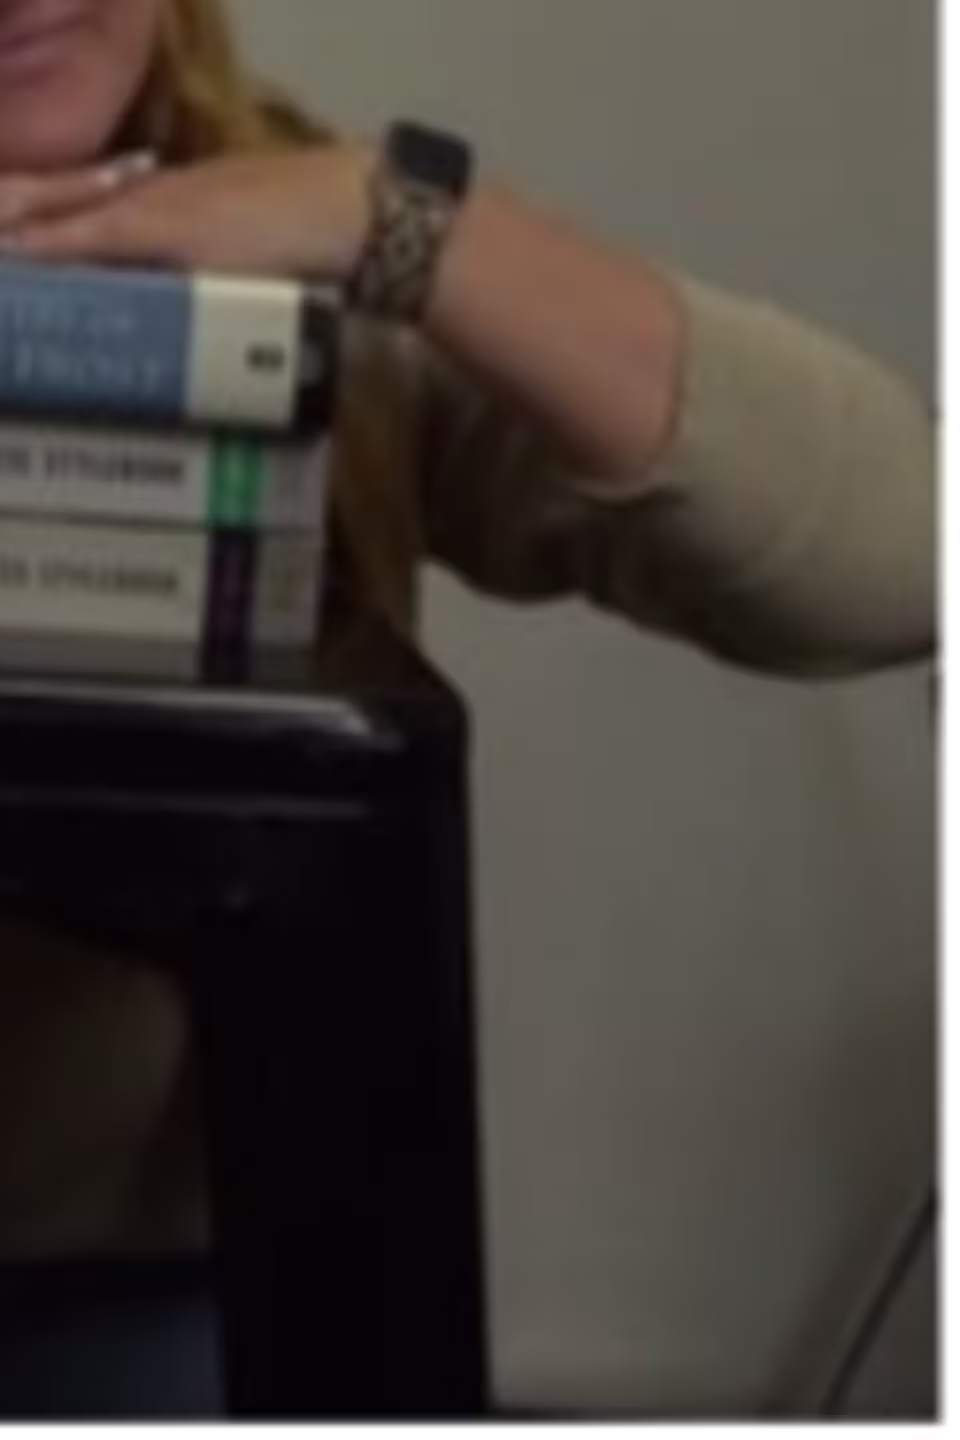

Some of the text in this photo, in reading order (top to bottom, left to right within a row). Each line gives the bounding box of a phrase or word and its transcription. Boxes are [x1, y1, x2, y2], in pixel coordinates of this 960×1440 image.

[14, 340, 163, 394] FROST
[43, 446, 185, 486] STYLEBOOK
[40, 559, 179, 596] STYLEBOOK
